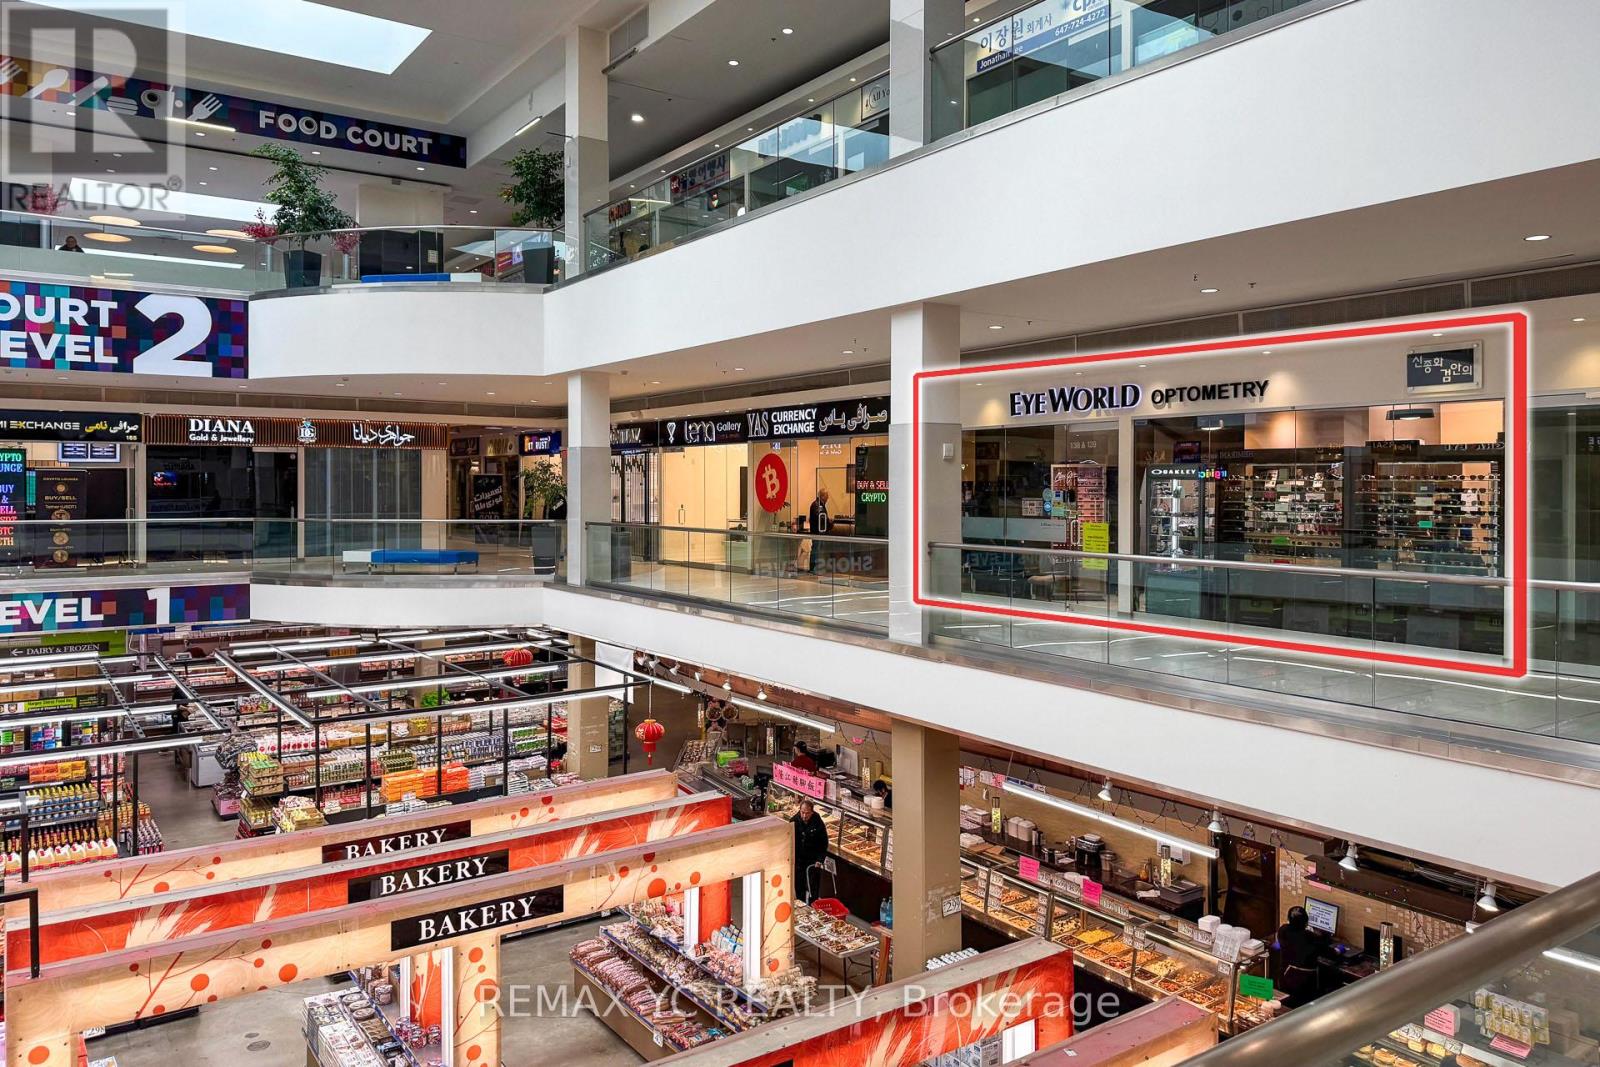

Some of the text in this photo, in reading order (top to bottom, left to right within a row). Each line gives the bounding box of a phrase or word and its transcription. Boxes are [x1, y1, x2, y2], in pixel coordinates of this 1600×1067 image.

[980, 13, 1052, 52] 이장원 회계사
[259, 110, 432, 155] FOOD COURT
[133, 293, 213, 377] 2
[1440, 363, 1473, 383] 검안의
[1151, 380, 1269, 405] OPTOMETRY
[10, 421, 80, 430] EXCHANGE
[189, 419, 255, 433] DIANA
[716, 422, 742, 432] Gallery
[746, 408, 817, 438] YAS CURRENCY
[774, 422, 815, 435] EXCHANGE
[189, 433, 208, 441] Gold
[220, 433, 254, 443] Jewellery
[861, 493, 886, 502] CRYPTO
[146, 587, 170, 625] 1
[27, 646, 53, 656] DAIRY
[64, 643, 100, 653] FROZEN
[345, 828, 447, 860] BAKERY
[380, 856, 489, 895] BAKERY
[418, 896, 536, 941] BAKERY
